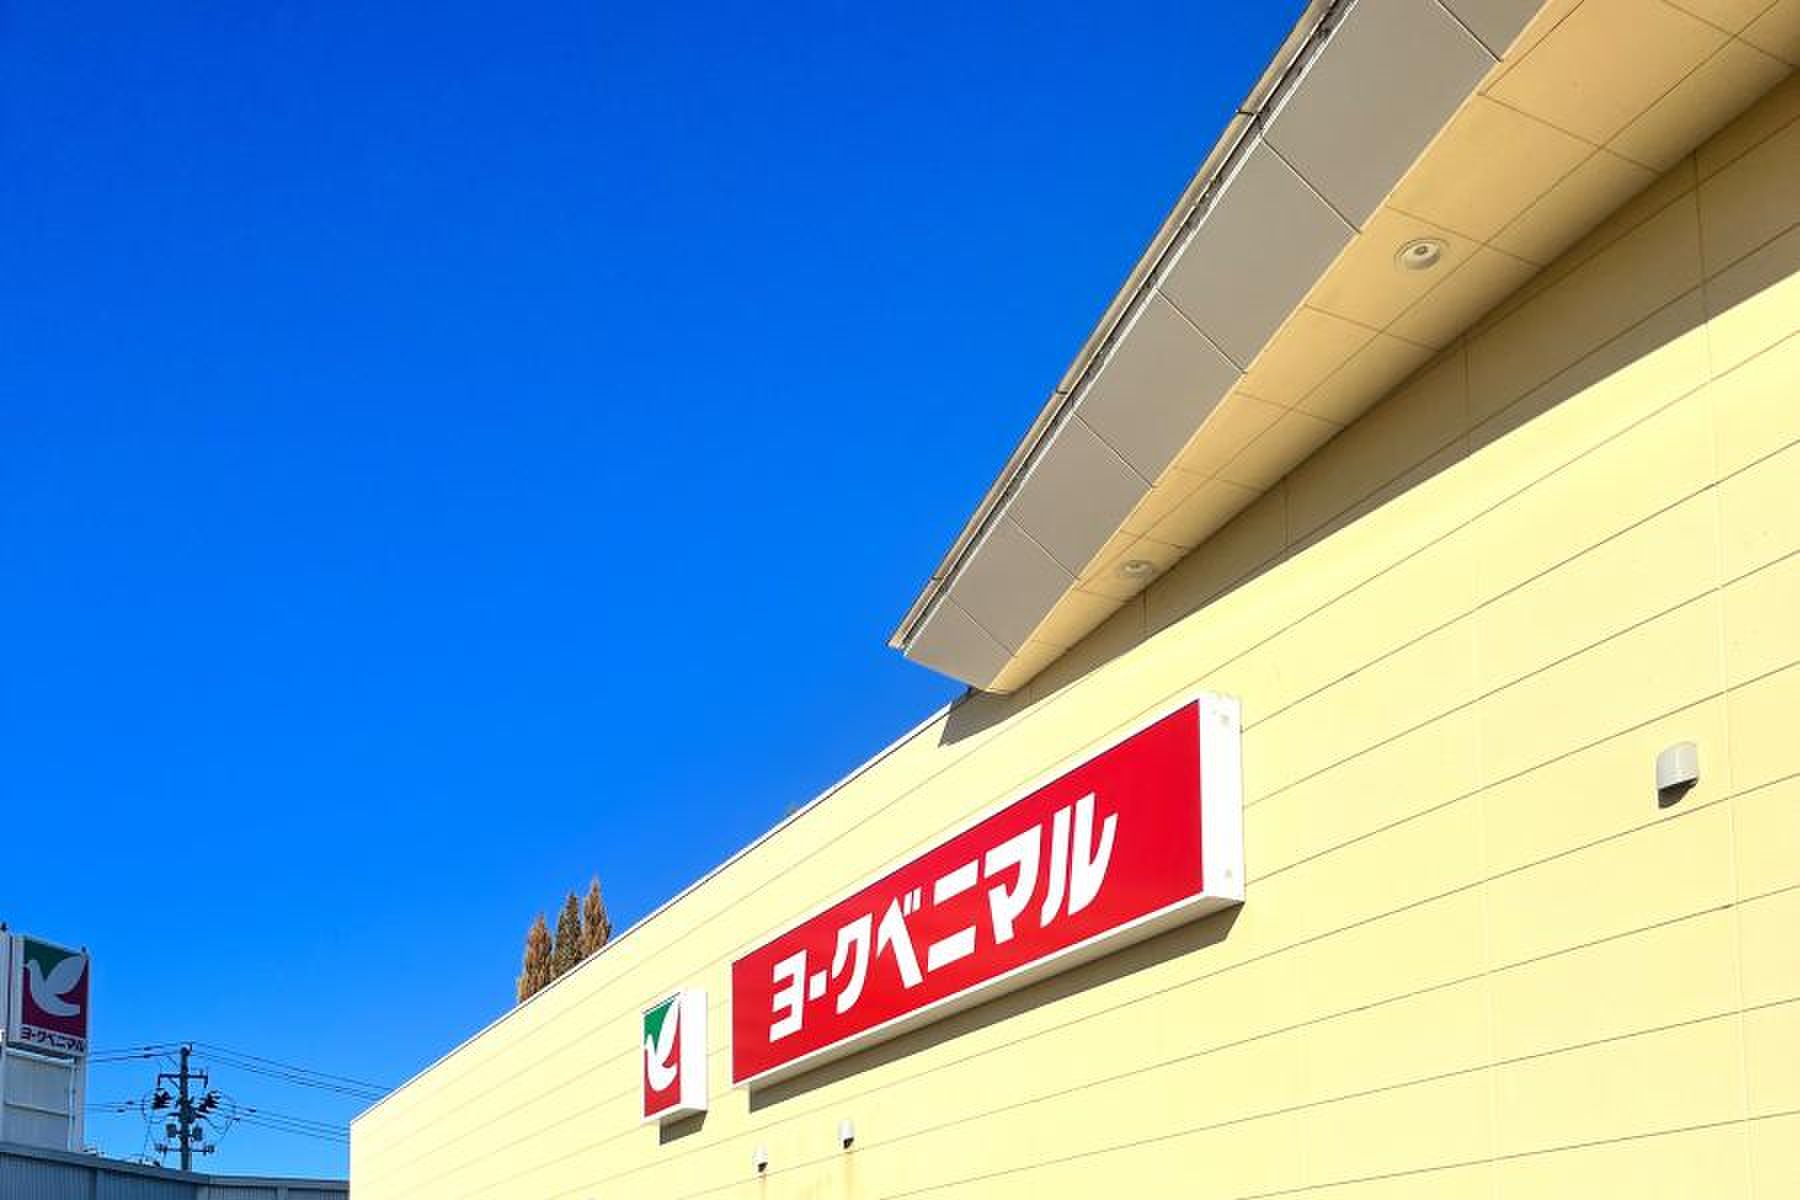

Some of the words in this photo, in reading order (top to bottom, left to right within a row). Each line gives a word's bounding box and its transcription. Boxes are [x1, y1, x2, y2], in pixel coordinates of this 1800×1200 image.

[769, 792, 1118, 1043] ヨークベニマル
[21, 1026, 85, 1052] ヨークベニマル
